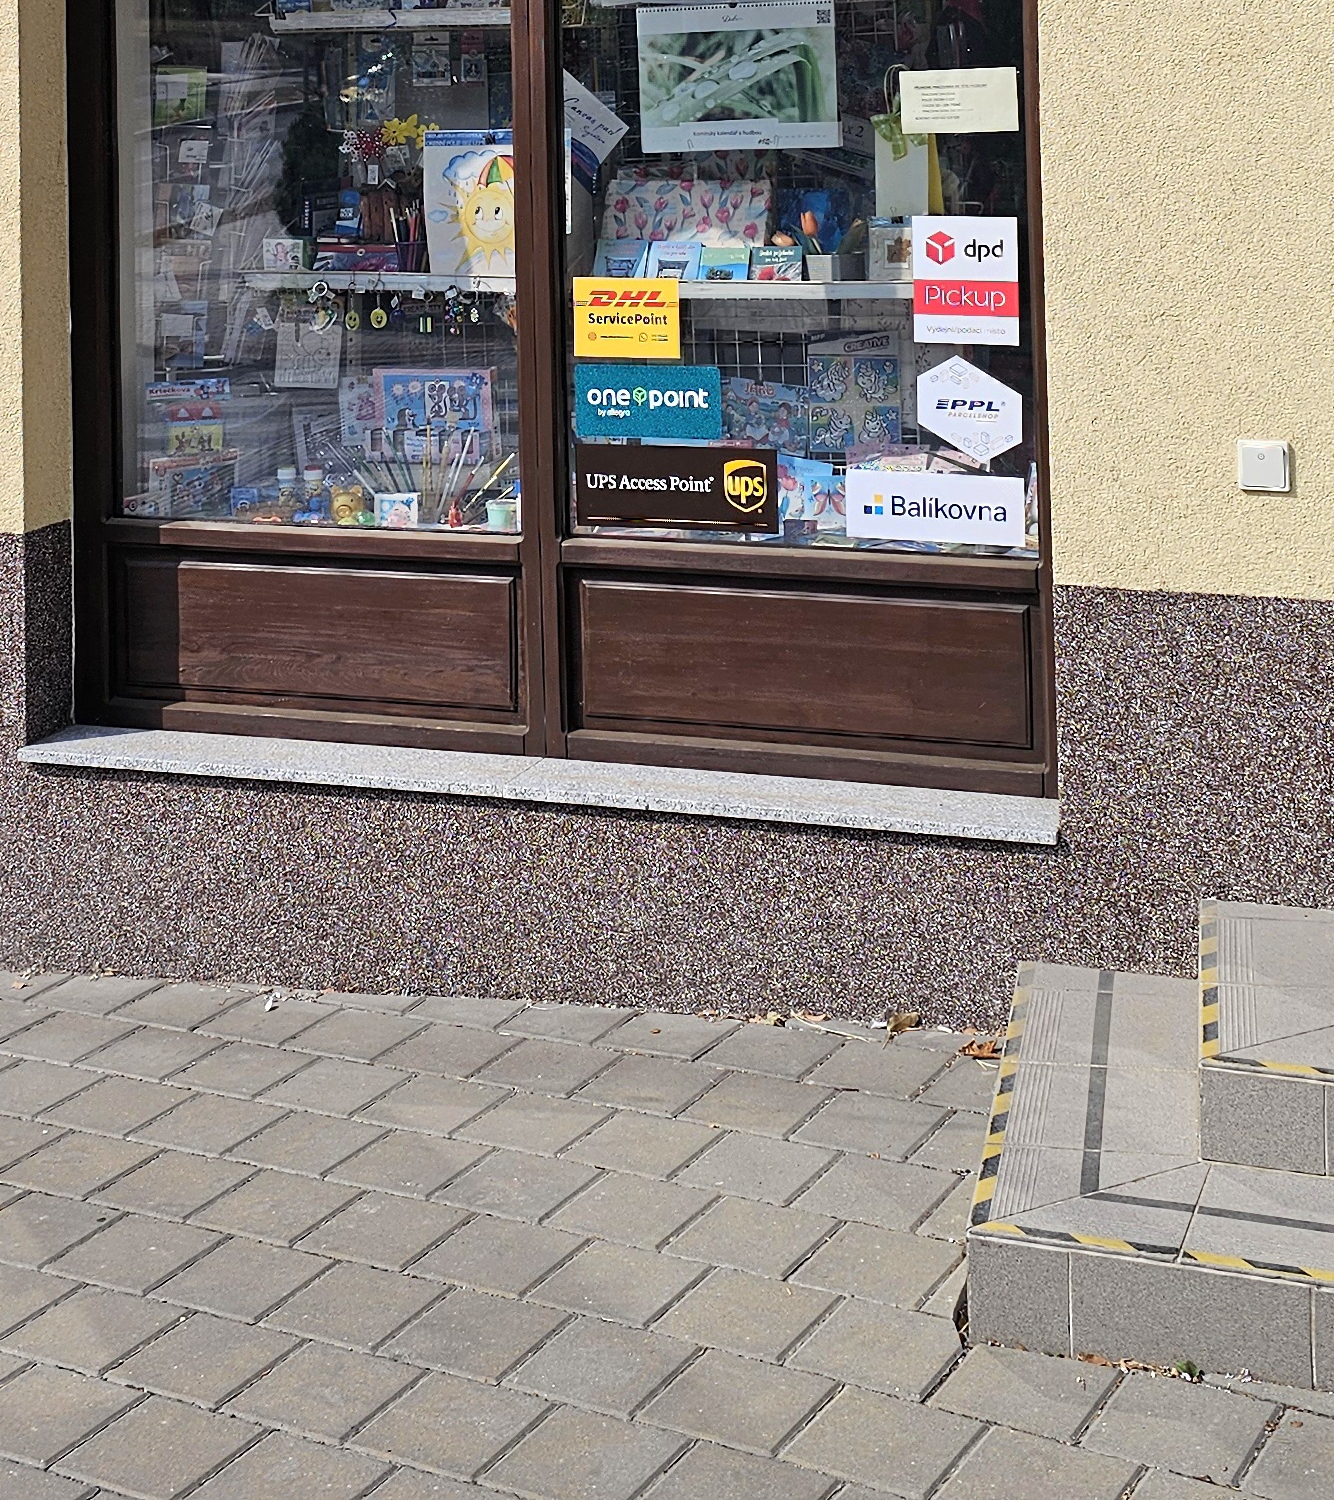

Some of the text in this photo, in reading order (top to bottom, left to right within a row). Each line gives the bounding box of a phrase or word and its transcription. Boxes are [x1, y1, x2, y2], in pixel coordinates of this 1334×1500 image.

[964, 239, 1003, 262] dpd
[588, 290, 666, 307] DHL
[925, 285, 1006, 311] Pickup
[588, 313, 667, 325] ServicePoint
[845, 336, 890, 351] CREATIVE
[586, 473, 617, 489] UPS
[619, 475, 667, 491] Access
[727, 476, 764, 504] ups
[891, 495, 1007, 522] Balíkovna
